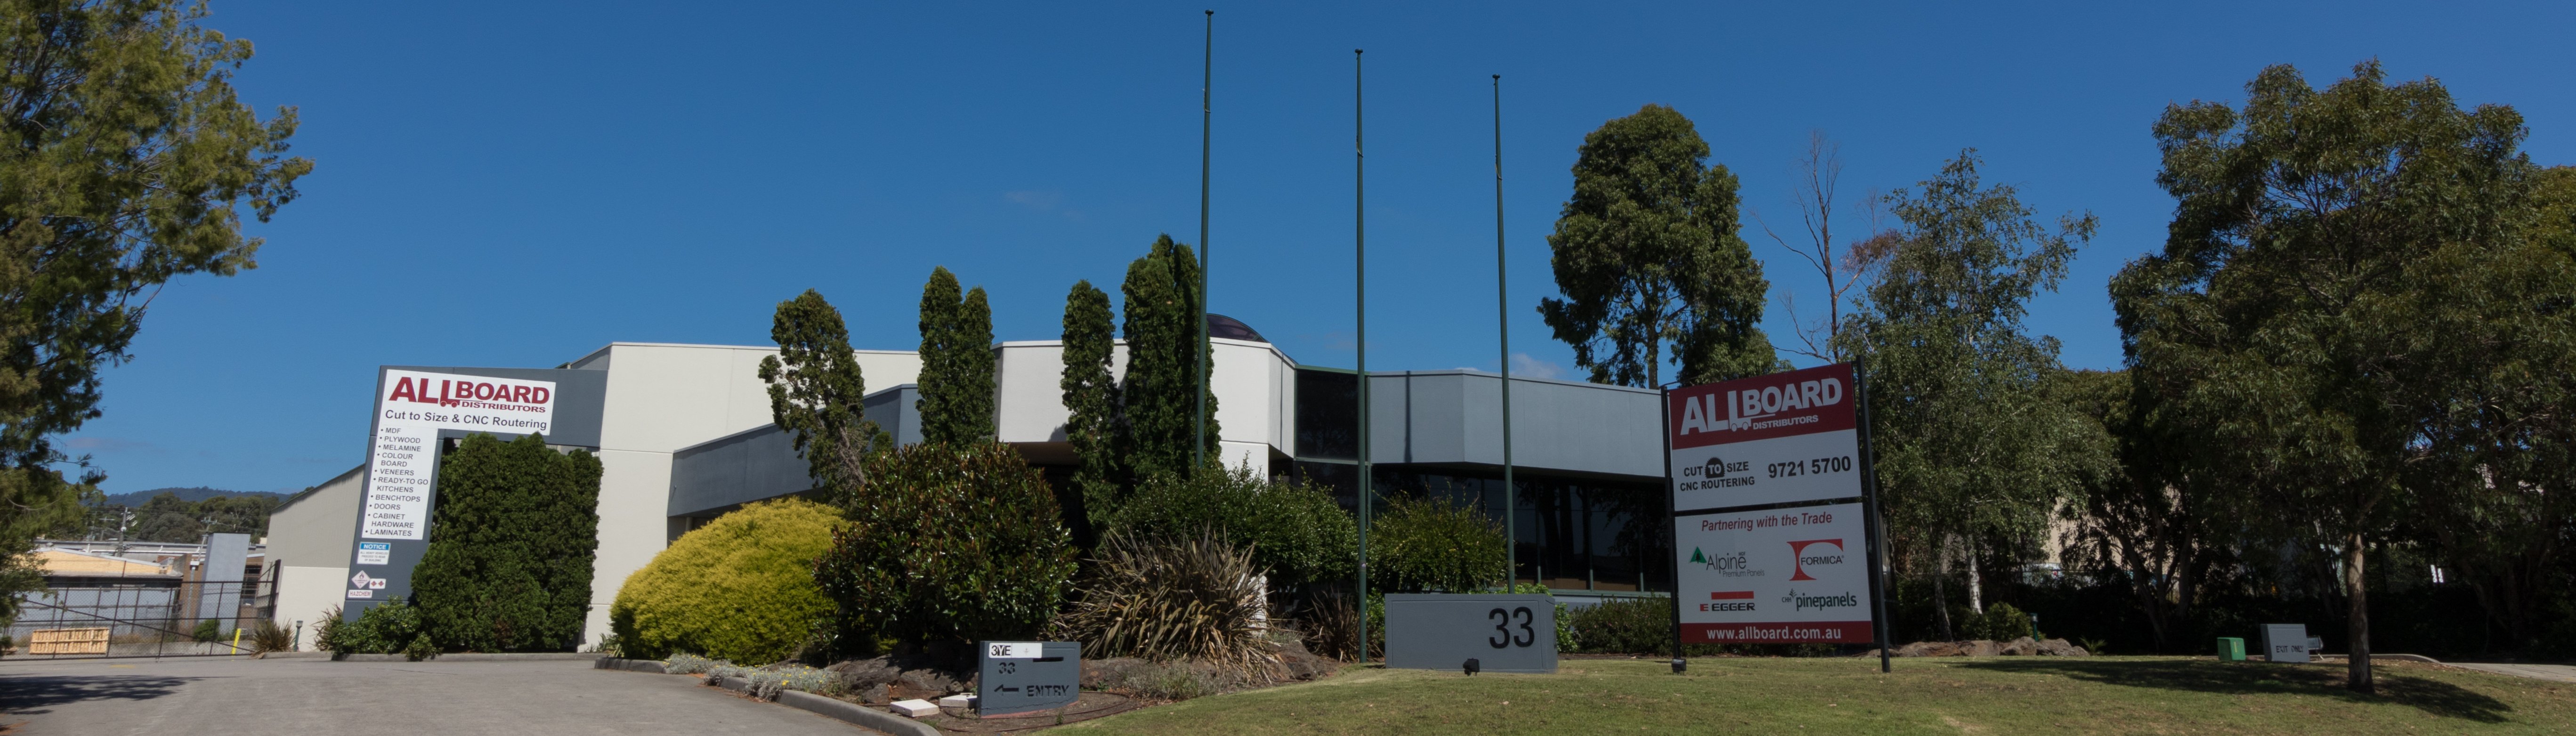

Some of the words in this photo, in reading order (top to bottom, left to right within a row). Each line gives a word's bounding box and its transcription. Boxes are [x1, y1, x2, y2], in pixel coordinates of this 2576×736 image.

[389, 377, 550, 408] ALLBOARD
[462, 401, 546, 412] DISTRIBUTORS
[1680, 378, 1842, 435] ALLBOARD
[385, 410, 406, 419] Cut
[410, 411, 420, 421] to
[424, 412, 448, 422] Size
[452, 414, 460, 423] &
[464, 415, 488, 425] CNC
[493, 417, 547, 431] Routering
[1753, 415, 1819, 430] DISTRIBUTORS
[1684, 466, 1703, 477] CUT
[1708, 464, 1721, 475] TO
[1726, 461, 1749, 472] SIZE
[1768, 460, 1805, 478] 9721
[1811, 456, 1851, 475] 5700
[1680, 482, 1698, 491] CNC
[1701, 476, 1755, 490] ROUTERING
[1701, 518, 1753, 532] Partnering
[1757, 515, 1778, 528] with
[1782, 514, 1798, 526] the
[1801, 511, 1832, 525] Trade
[1706, 553, 1746, 574] Alpine
[1801, 556, 1842, 565] FORMICA
[1747, 569, 1765, 577] Panels
[1712, 603, 1755, 611] EGGER
[1796, 591, 1857, 612] pinepanels
[1489, 607, 1535, 649] 33
[1707, 626, 1841, 639] www.allboard.com.au
[991, 645, 1011, 656] 3YE
[998, 662, 1015, 674] 33
[1027, 685, 1069, 697] ENTRY
